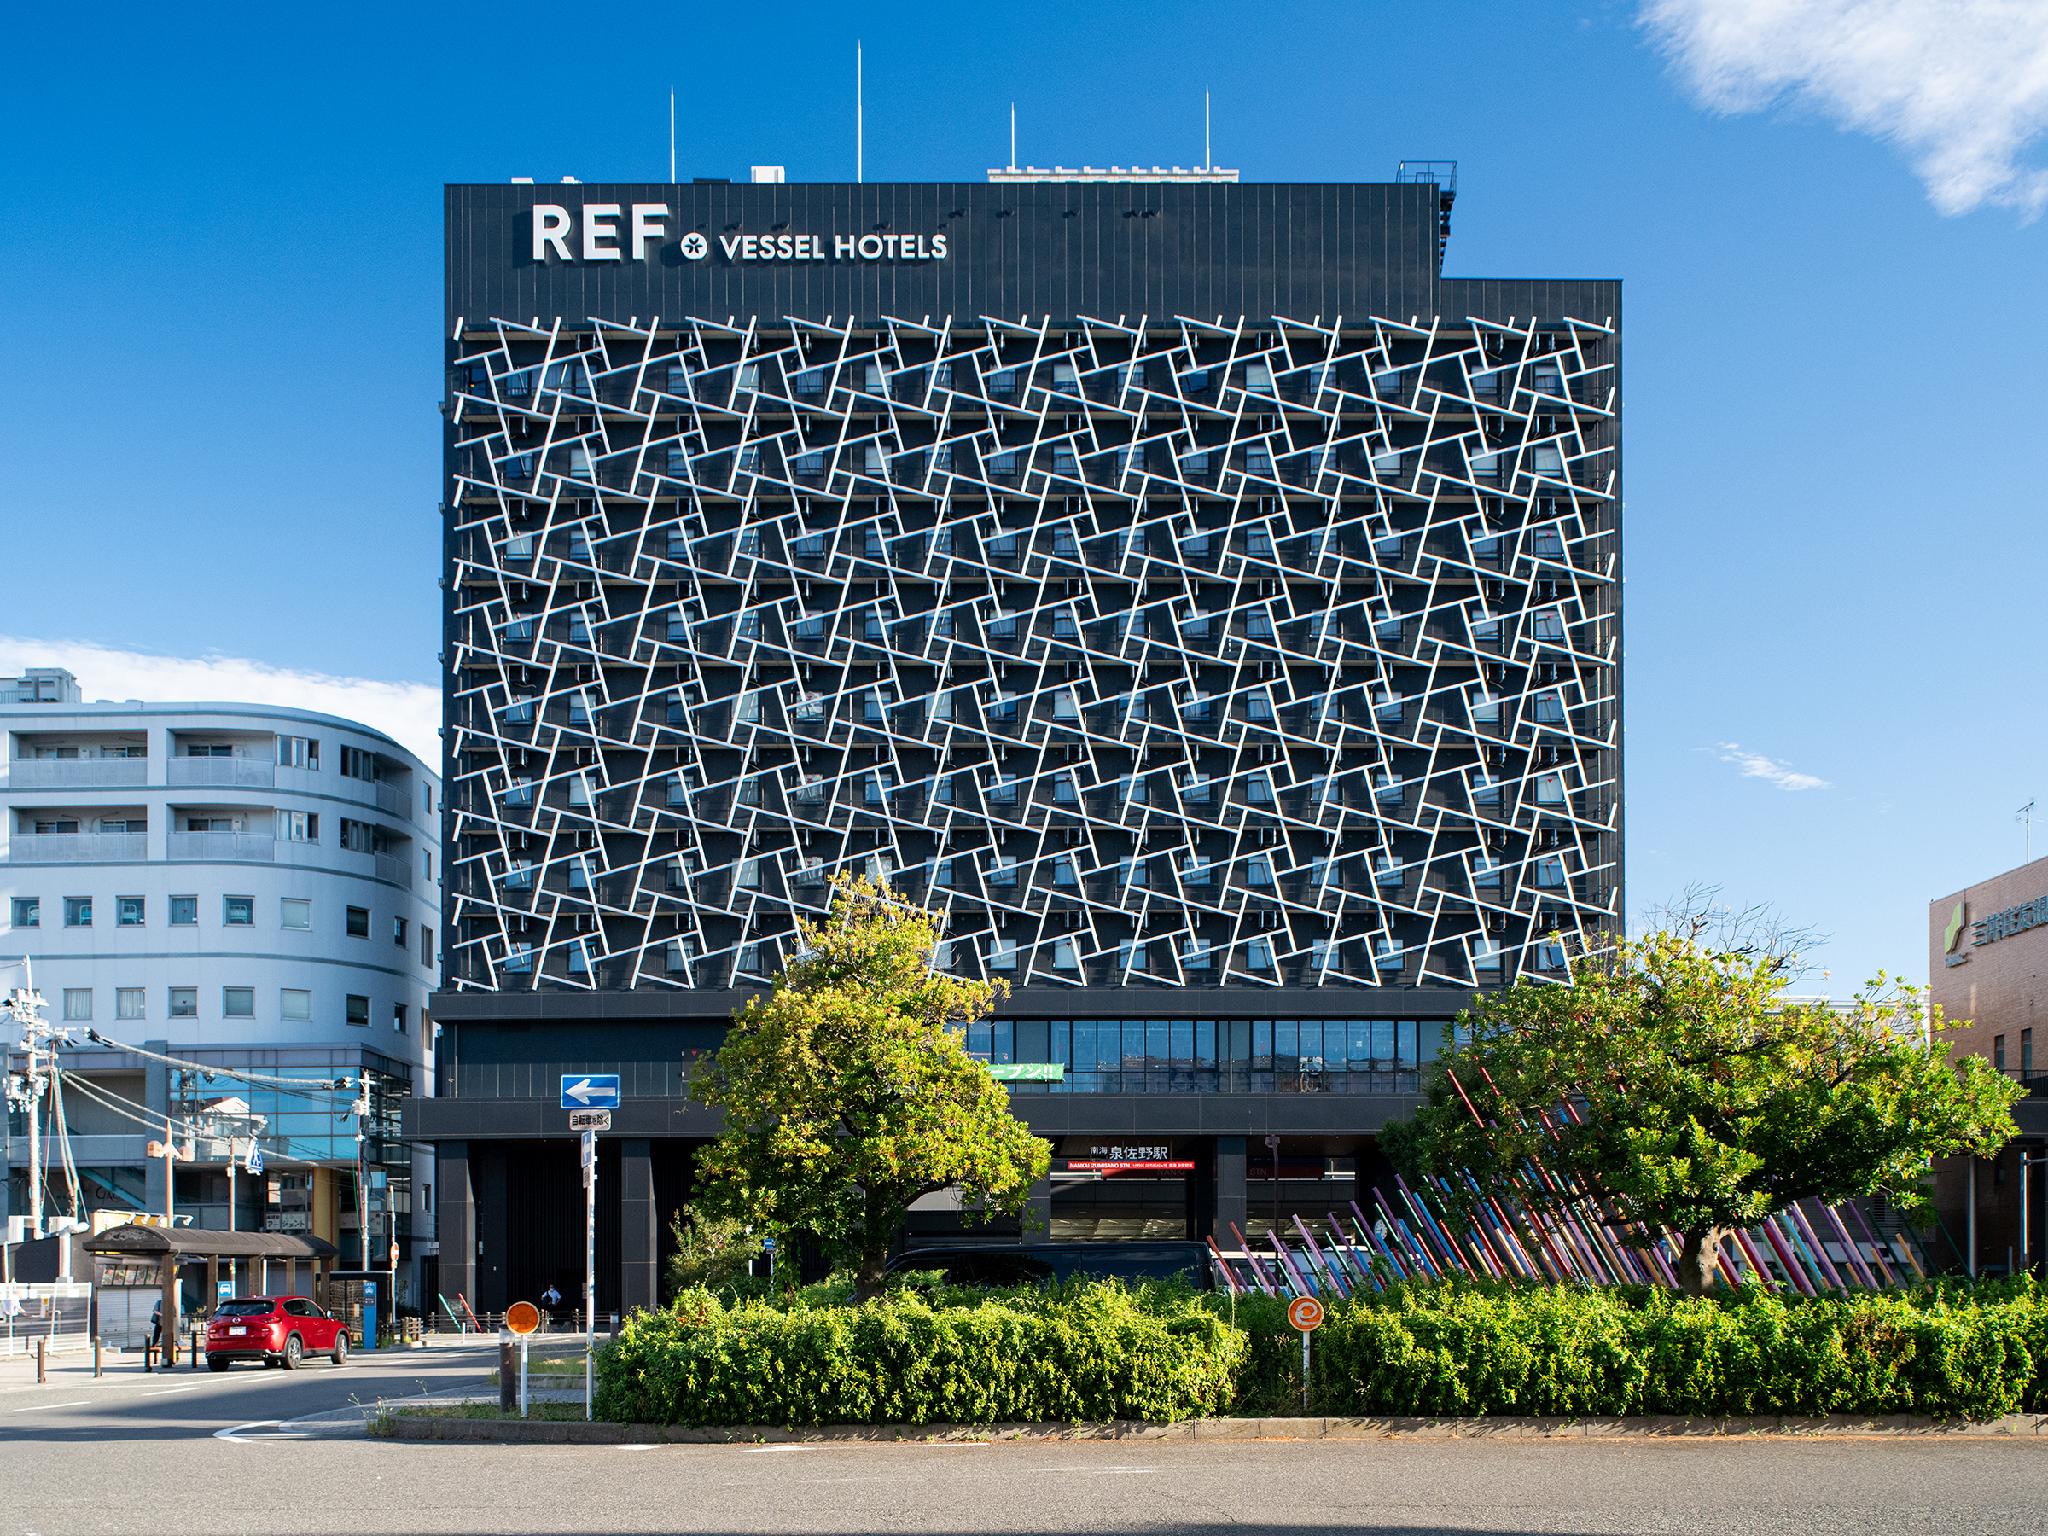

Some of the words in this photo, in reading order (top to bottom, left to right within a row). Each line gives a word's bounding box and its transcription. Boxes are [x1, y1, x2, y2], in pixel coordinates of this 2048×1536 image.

[532, 203, 669, 260] REF
[719, 234, 825, 260] VESSEL
[834, 234, 948, 260] HOTELS
[1109, 1146, 1168, 1160] 泉佐野駅
